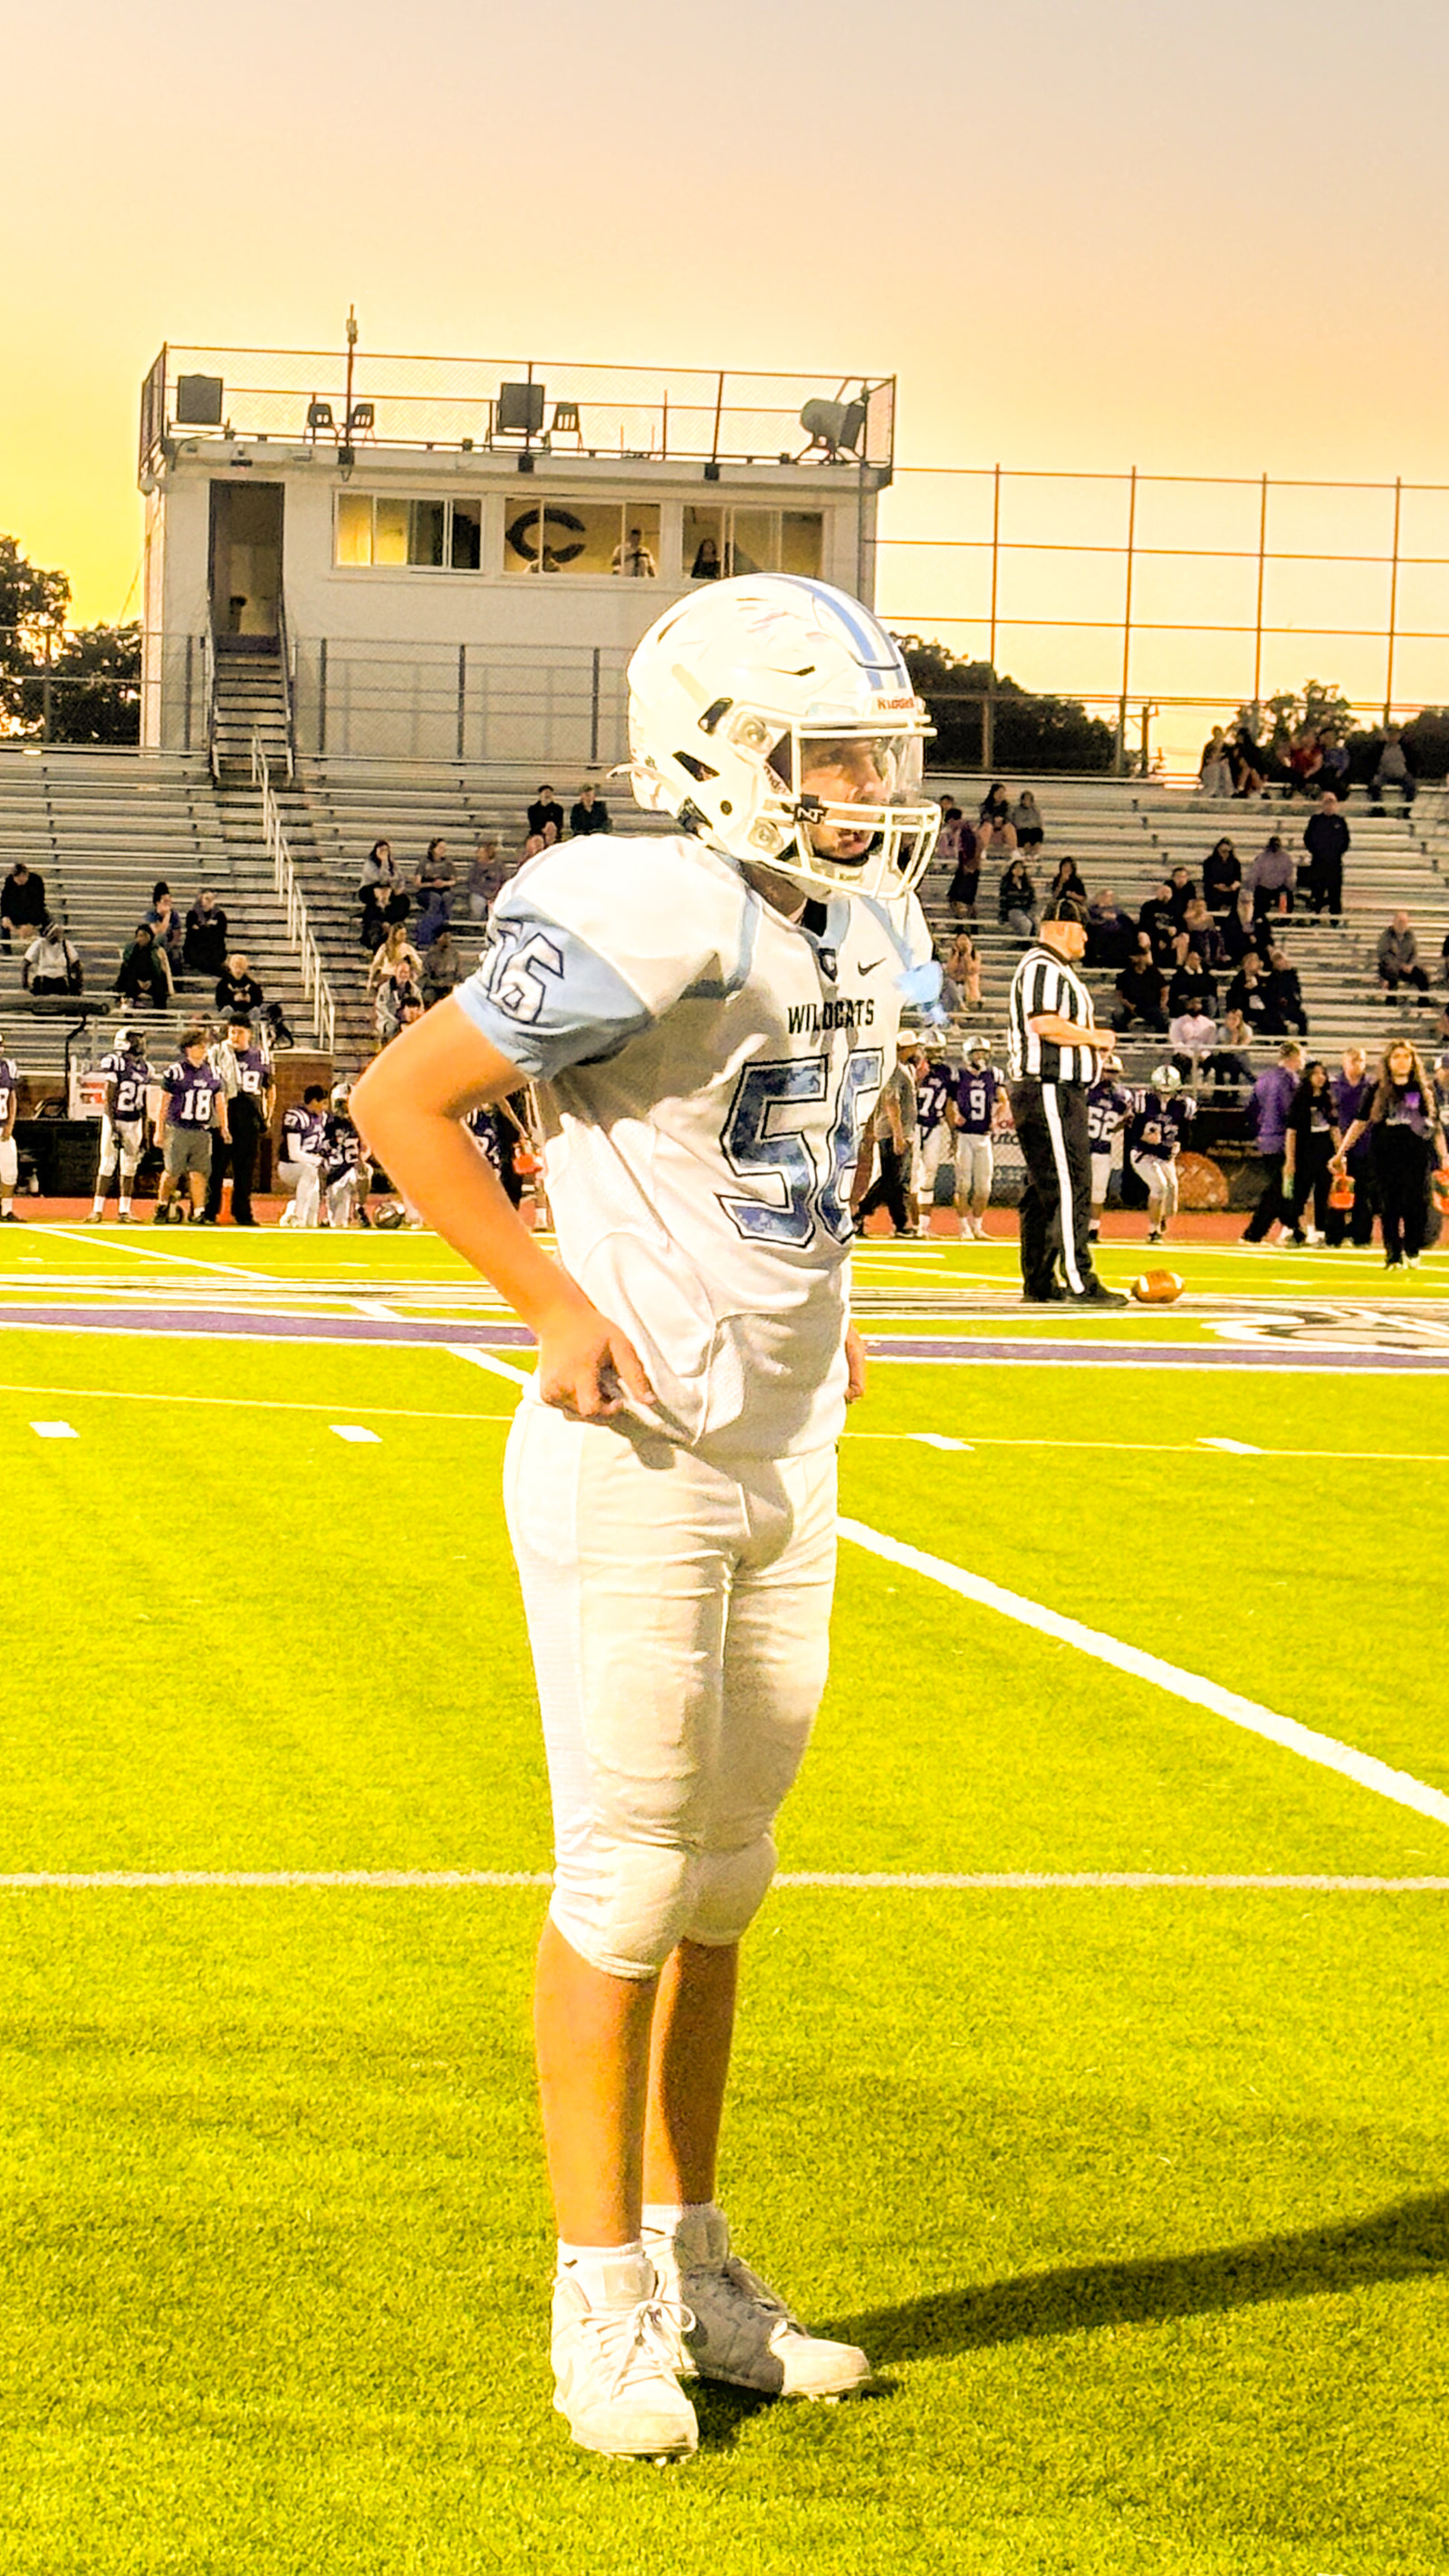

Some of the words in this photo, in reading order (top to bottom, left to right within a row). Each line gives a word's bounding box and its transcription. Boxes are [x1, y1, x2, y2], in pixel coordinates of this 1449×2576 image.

[787, 998, 875, 1034] WILDCATS
[180, 1089, 213, 1121] 18
[969, 1089, 986, 1120] 9
[1088, 1106, 1119, 1141] 52
